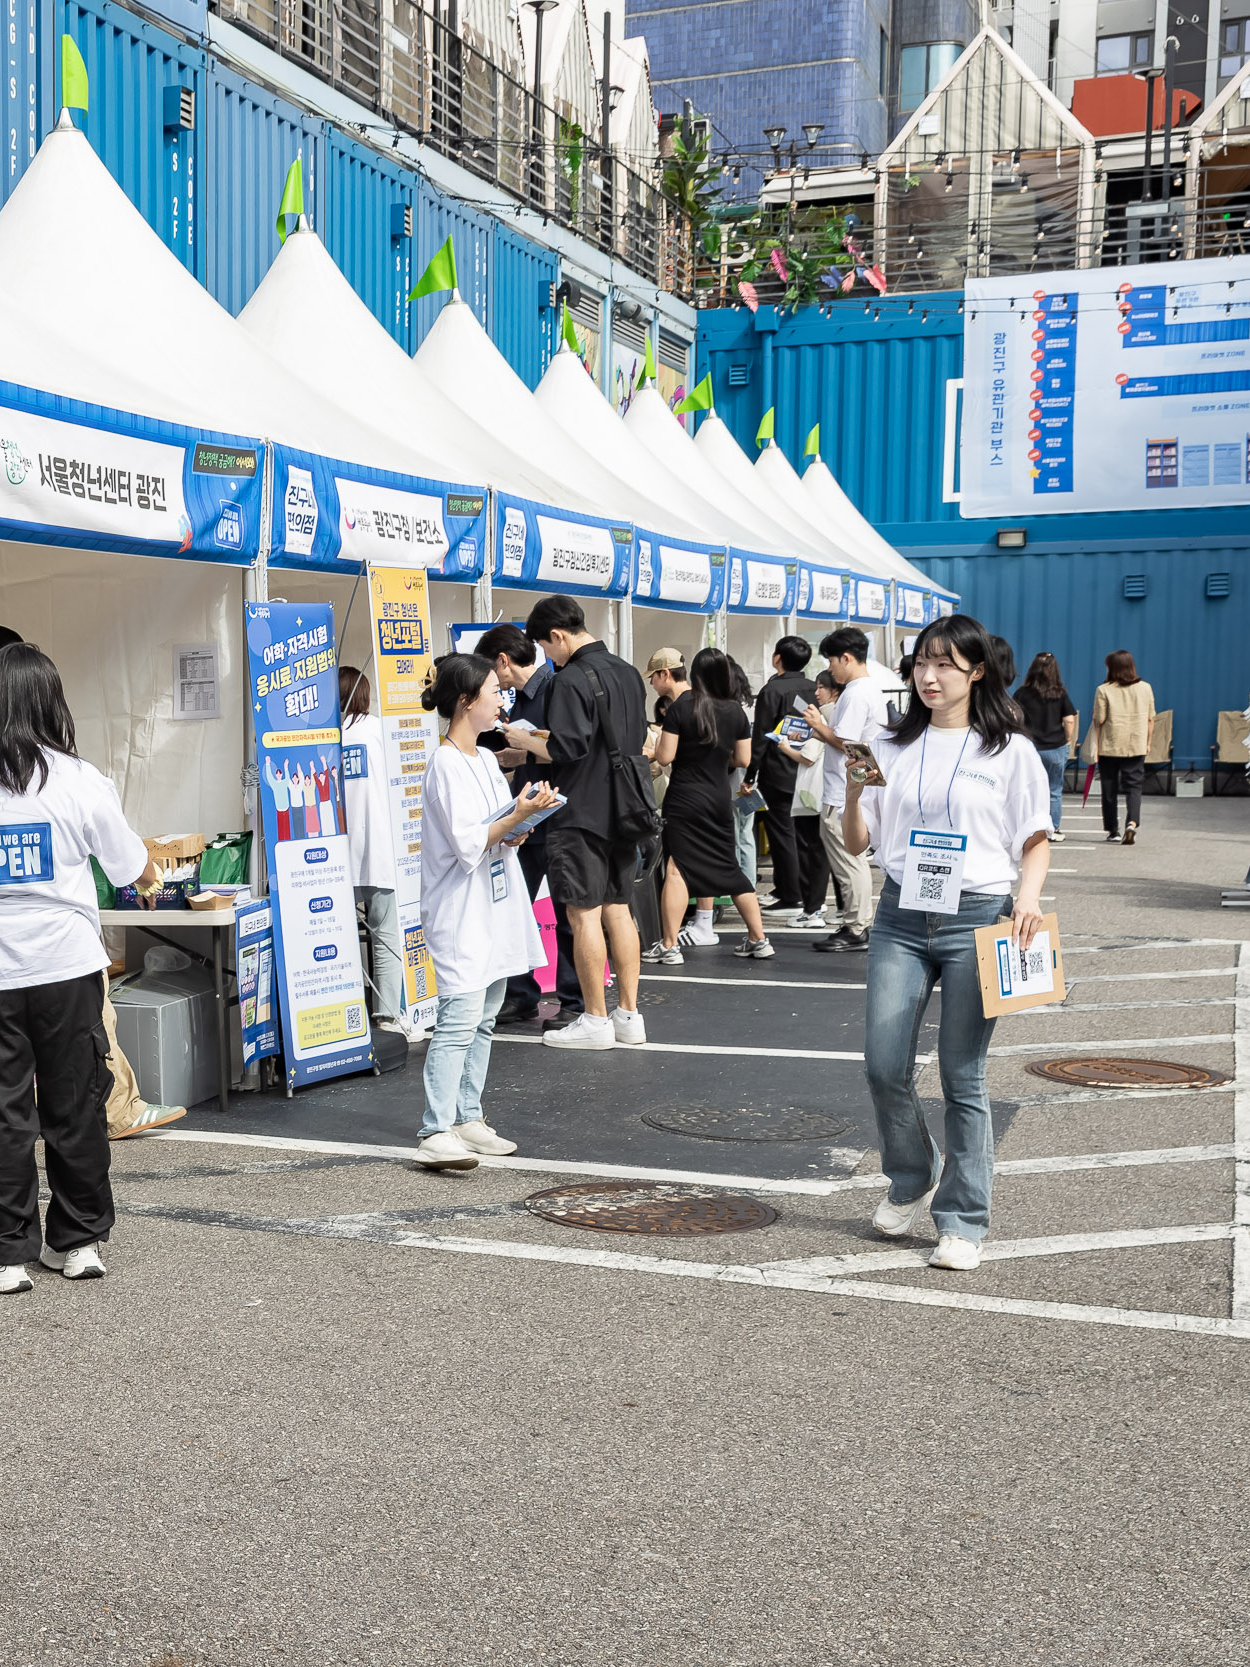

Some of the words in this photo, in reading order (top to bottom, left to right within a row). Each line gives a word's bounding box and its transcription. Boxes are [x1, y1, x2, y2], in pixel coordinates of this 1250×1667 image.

[29, 6, 35, 54] ID
[10, 127, 17, 176] 2F
[172, 196, 179, 239] 2F
[992, 332, 1007, 374] 광진구
[1226, 350, 1246, 358] ZONE
[38, 453, 133, 507] 서울청년센터
[135, 473, 168, 512] 광진
[217, 518, 240, 544] OPEN
[287, 511, 316, 536] 편의점
[372, 510, 411, 542] 광진구청
[415, 517, 444, 545] 보건소
[382, 602, 400, 618] 광진구
[400, 602, 419, 618] 청년은
[263, 624, 329, 666] 어학·자격시험
[380, 619, 424, 650] 청년포털
[256, 664, 292, 698] 응시료
[293, 646, 337, 683] 지원범위
[284, 684, 319, 718] 확대!
[349, 748, 362, 759] are
[2, 833, 19, 847] we
[21, 832, 41, 845] are
[305, 849, 327, 861] 지원대상
[920, 851, 938, 859] 만족도
[310, 898, 332, 911] 신청기간
[314, 946, 336, 959] 지원내용
